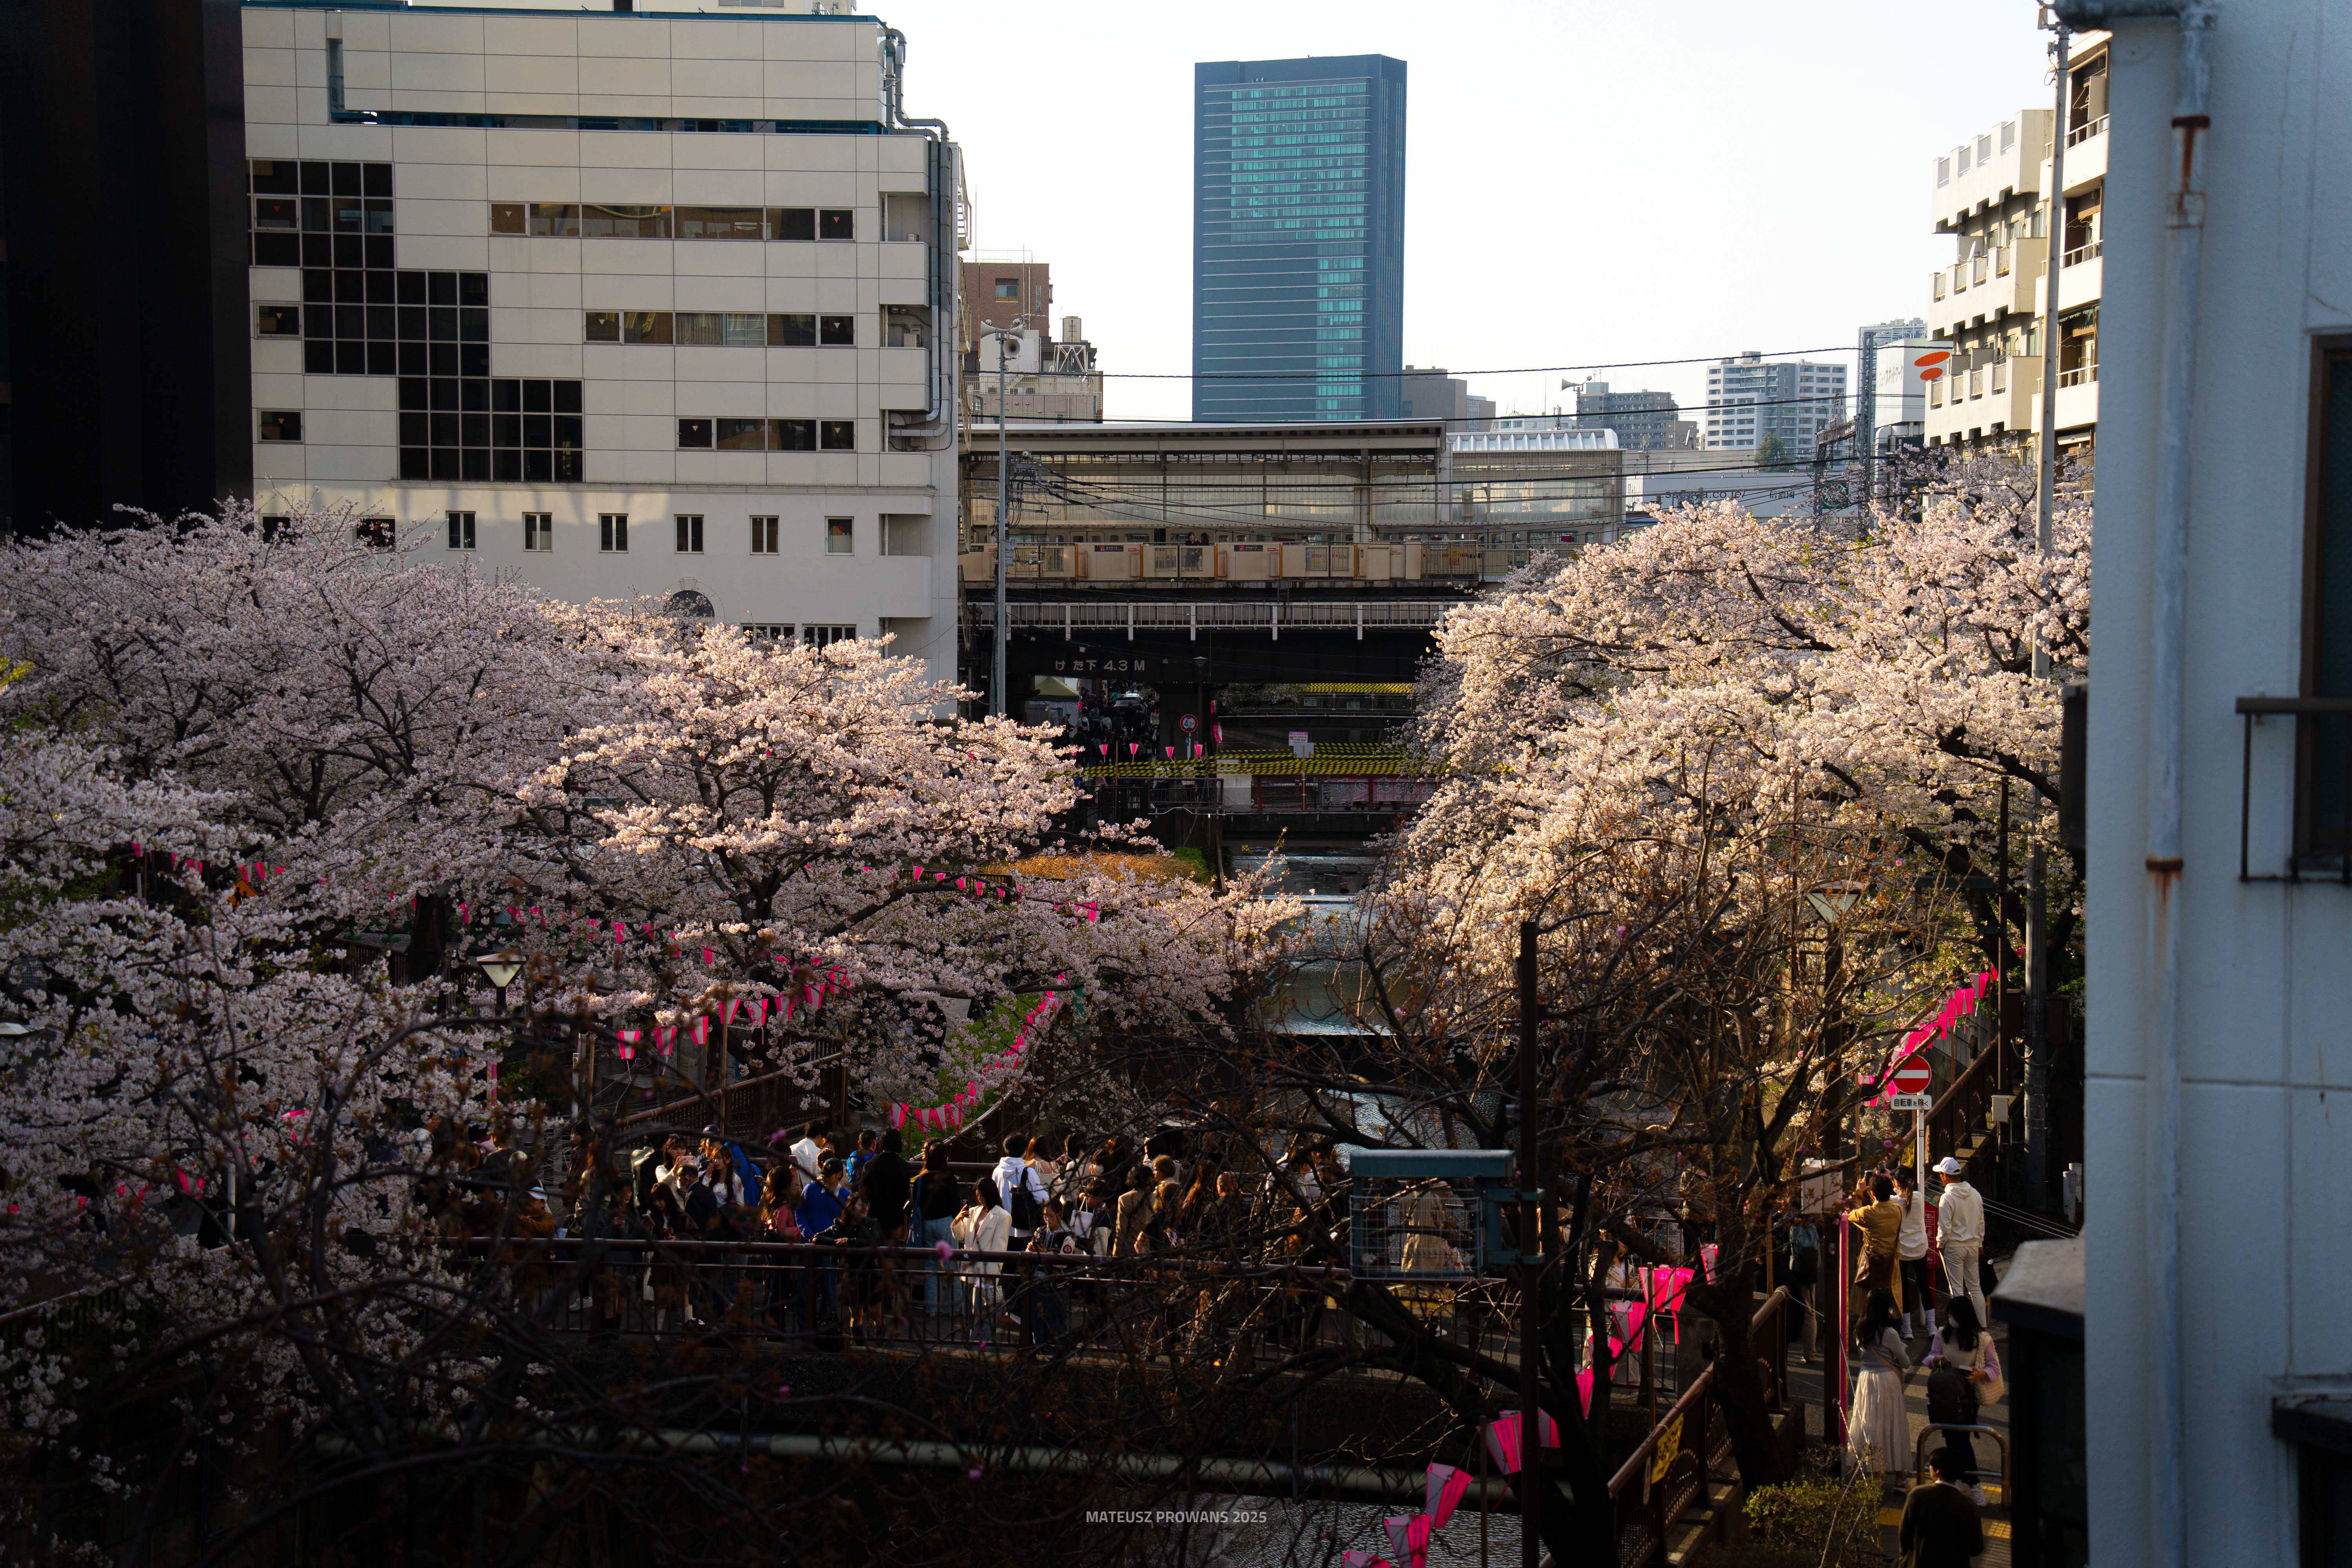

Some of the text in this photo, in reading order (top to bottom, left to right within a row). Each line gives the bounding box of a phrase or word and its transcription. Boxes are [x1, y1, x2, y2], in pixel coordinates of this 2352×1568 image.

[1055, 660, 1145, 671] けた下 4.3 M
[1894, 1098, 1929, 1107] 自転車を除く
